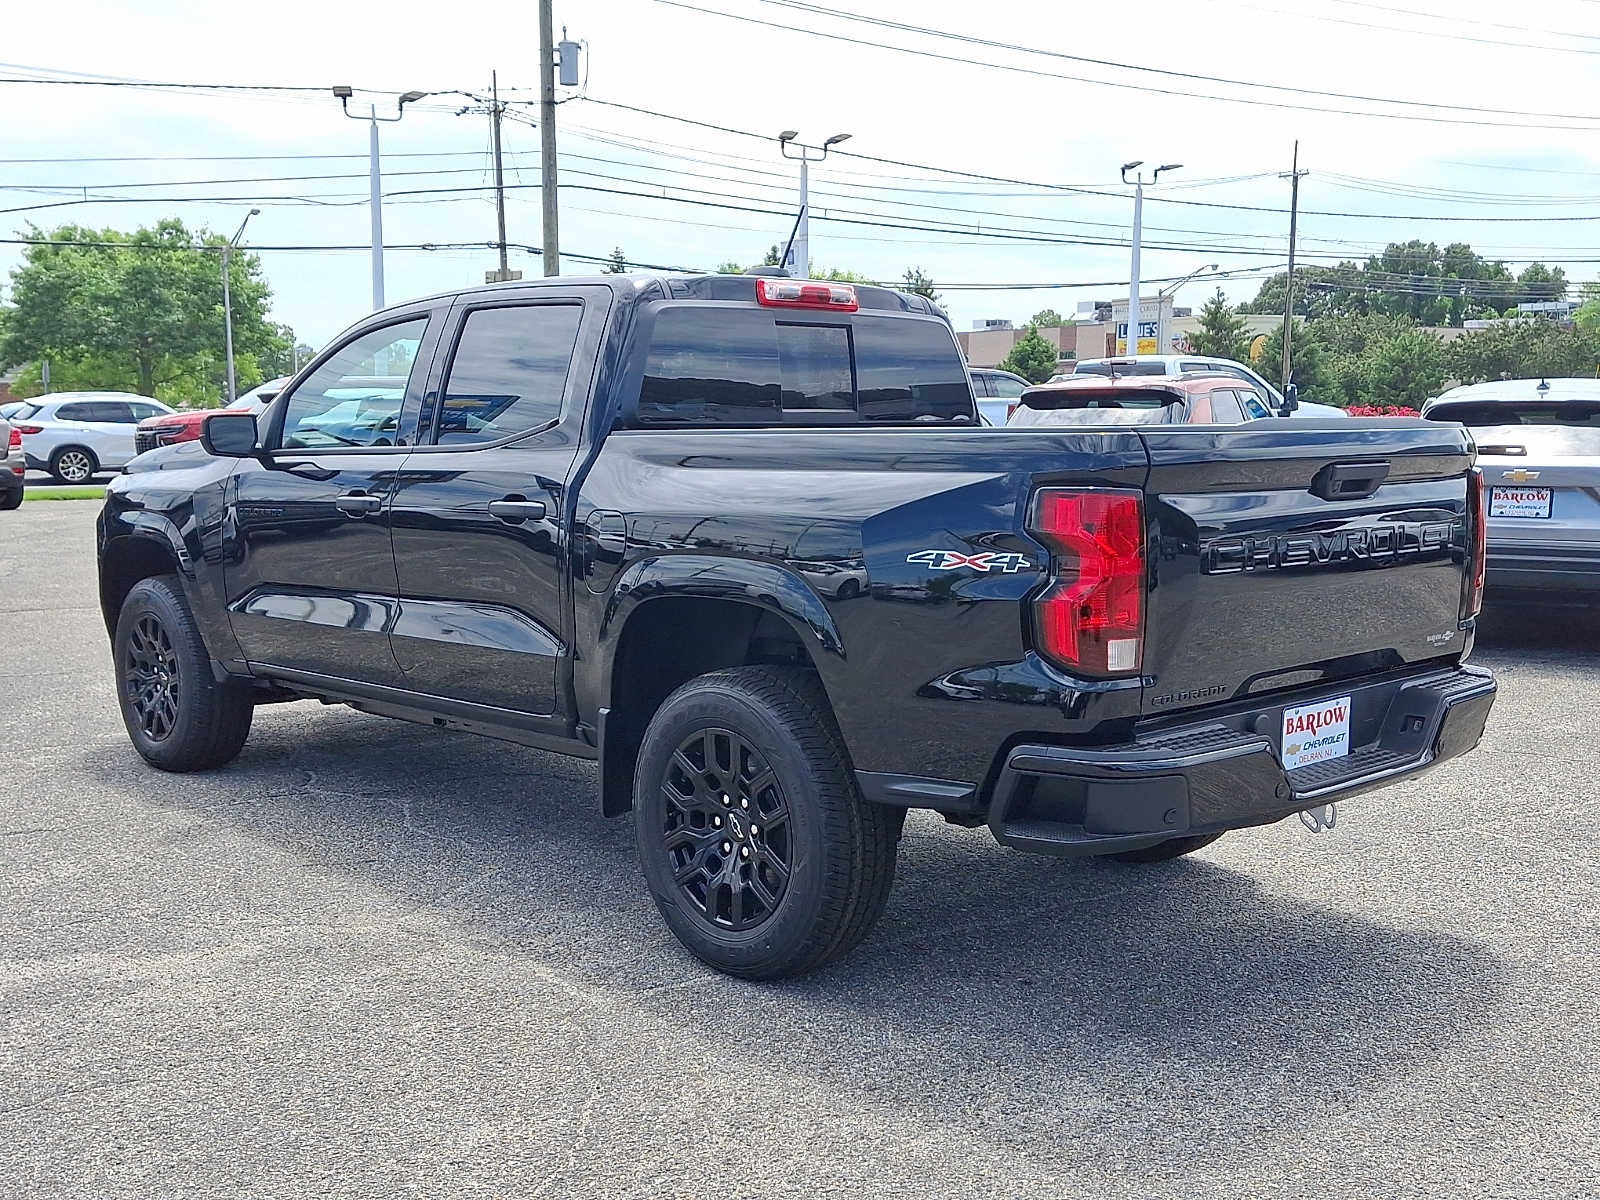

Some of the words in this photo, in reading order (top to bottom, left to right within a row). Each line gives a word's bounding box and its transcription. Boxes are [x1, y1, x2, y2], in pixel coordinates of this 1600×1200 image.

[1493, 492, 1548, 503] BARLOW
[1286, 706, 1347, 736] BARLOW
[1303, 733, 1346, 750] CHEVROLET
